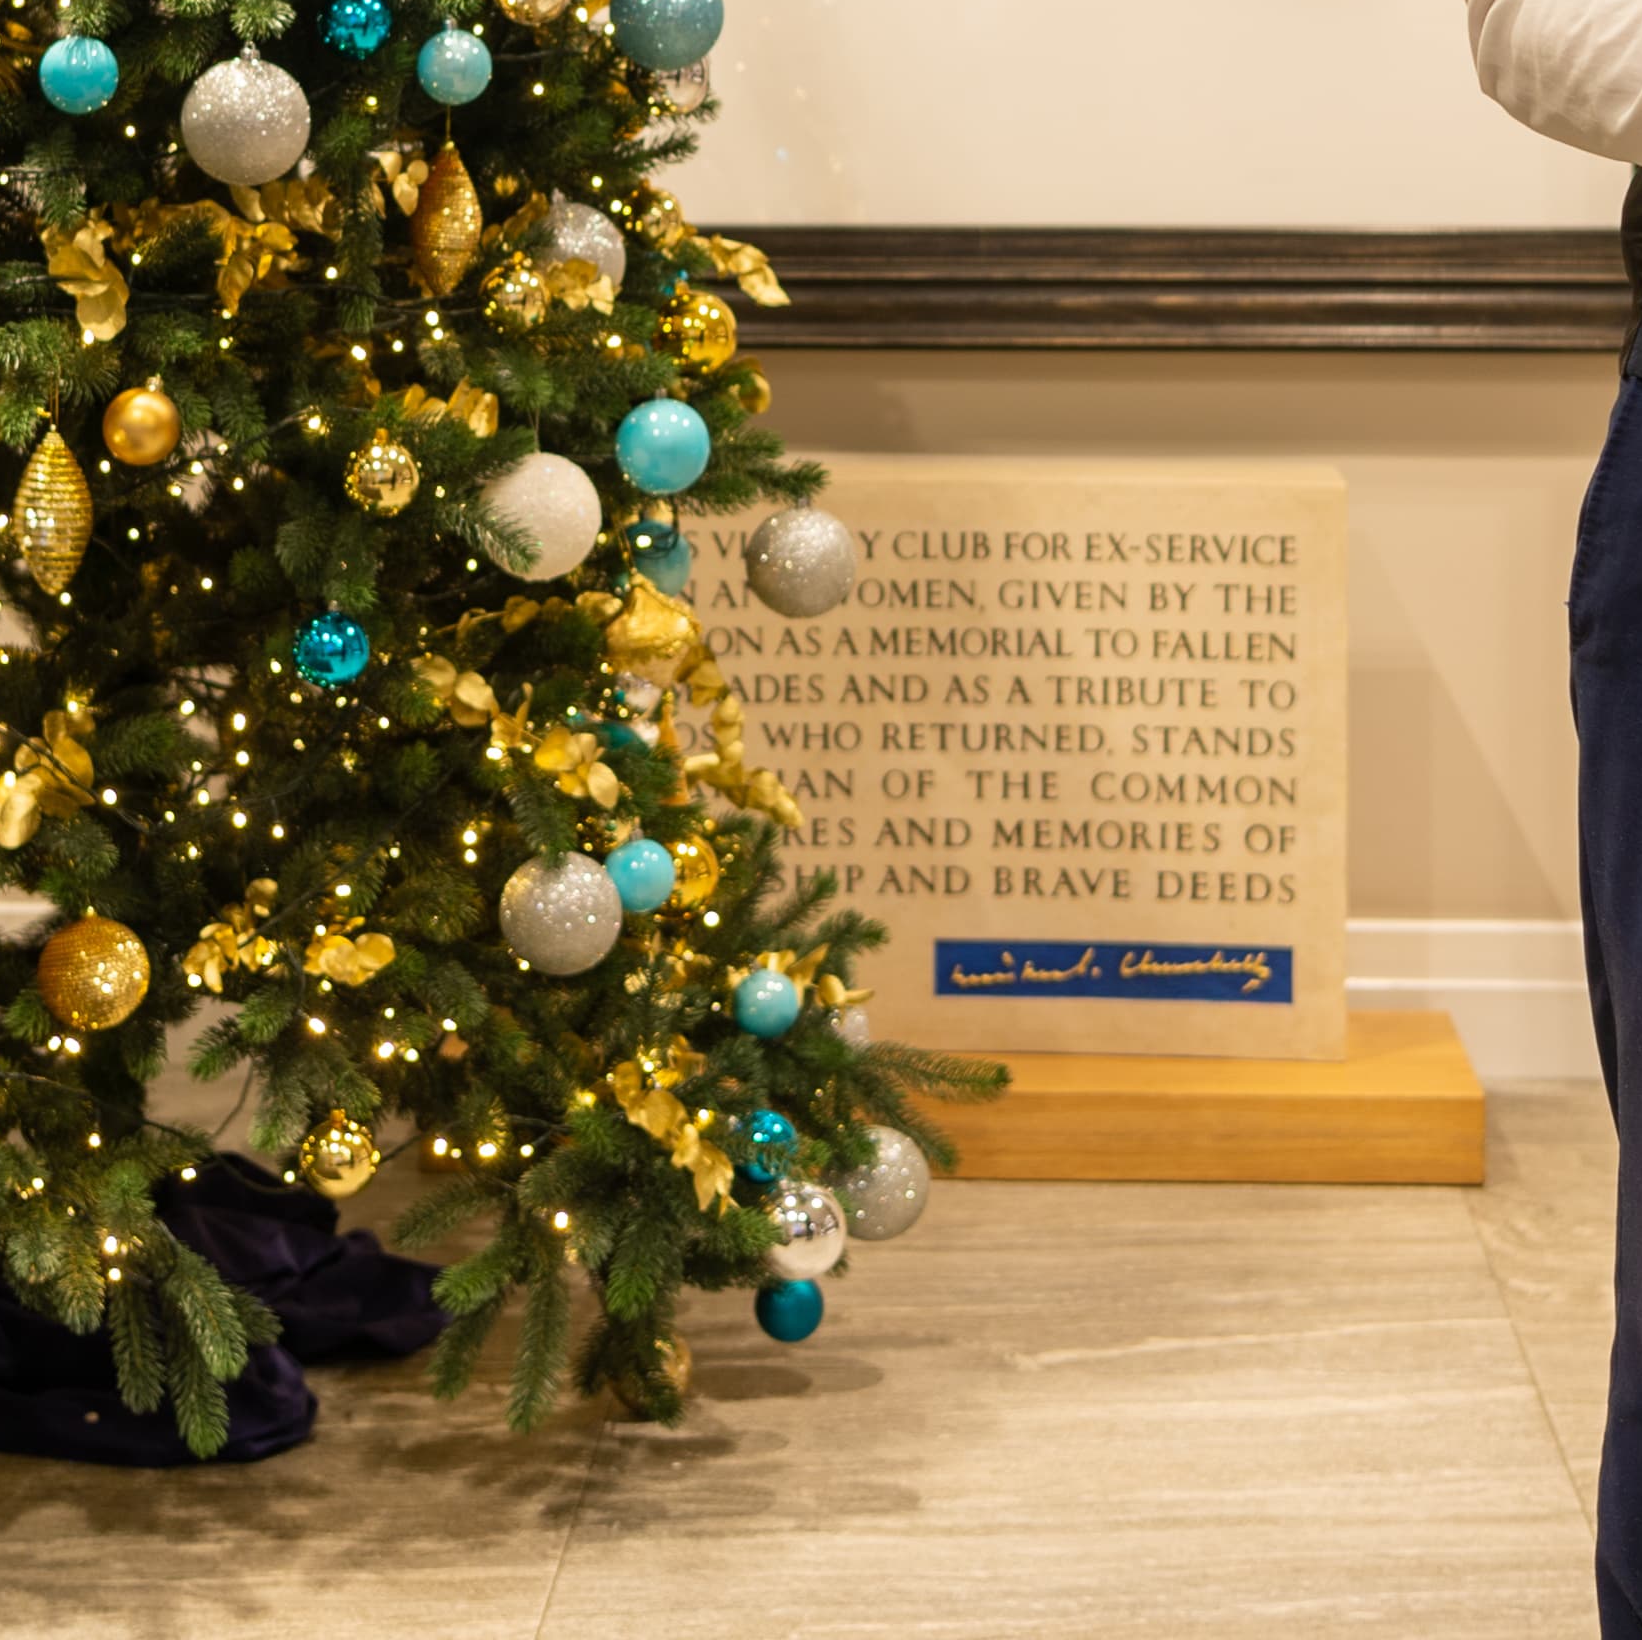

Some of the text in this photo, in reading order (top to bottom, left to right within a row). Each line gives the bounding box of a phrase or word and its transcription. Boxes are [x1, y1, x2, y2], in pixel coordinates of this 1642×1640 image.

[892, 532, 991, 561] CLUB
[1003, 532, 1071, 562] FOR
[1085, 533, 1296, 566] EX-SERVICE
[841, 578, 1295, 615] OMEN, GIVEN BY THE
[776, 627, 821, 656] AS
[834, 628, 858, 656] A
[870, 627, 1073, 659] MEMORIAL
[1085, 629, 1139, 659] TO
[1153, 630, 1295, 662] FALLEN
[840, 675, 929, 704] AND
[944, 675, 989, 704] AS
[1007, 676, 1032, 704] A
[1045, 675, 1216, 708] TRIBUTE
[1240, 680, 1296, 710] TO
[762, 722, 861, 751] WHO
[1133, 725, 1295, 757] STANDS
[881, 770, 933, 800] OF
[966, 770, 1057, 800] THE
[1090, 771, 1296, 806] COMMON
[875, 818, 971, 848] AND
[992, 819, 1219, 852] MEMORIES
[1244, 824, 1294, 854] OF
[878, 865, 970, 896] AND
[994, 866, 1130, 899] BRAVE
[1156, 871, 1295, 903] DEEDS
